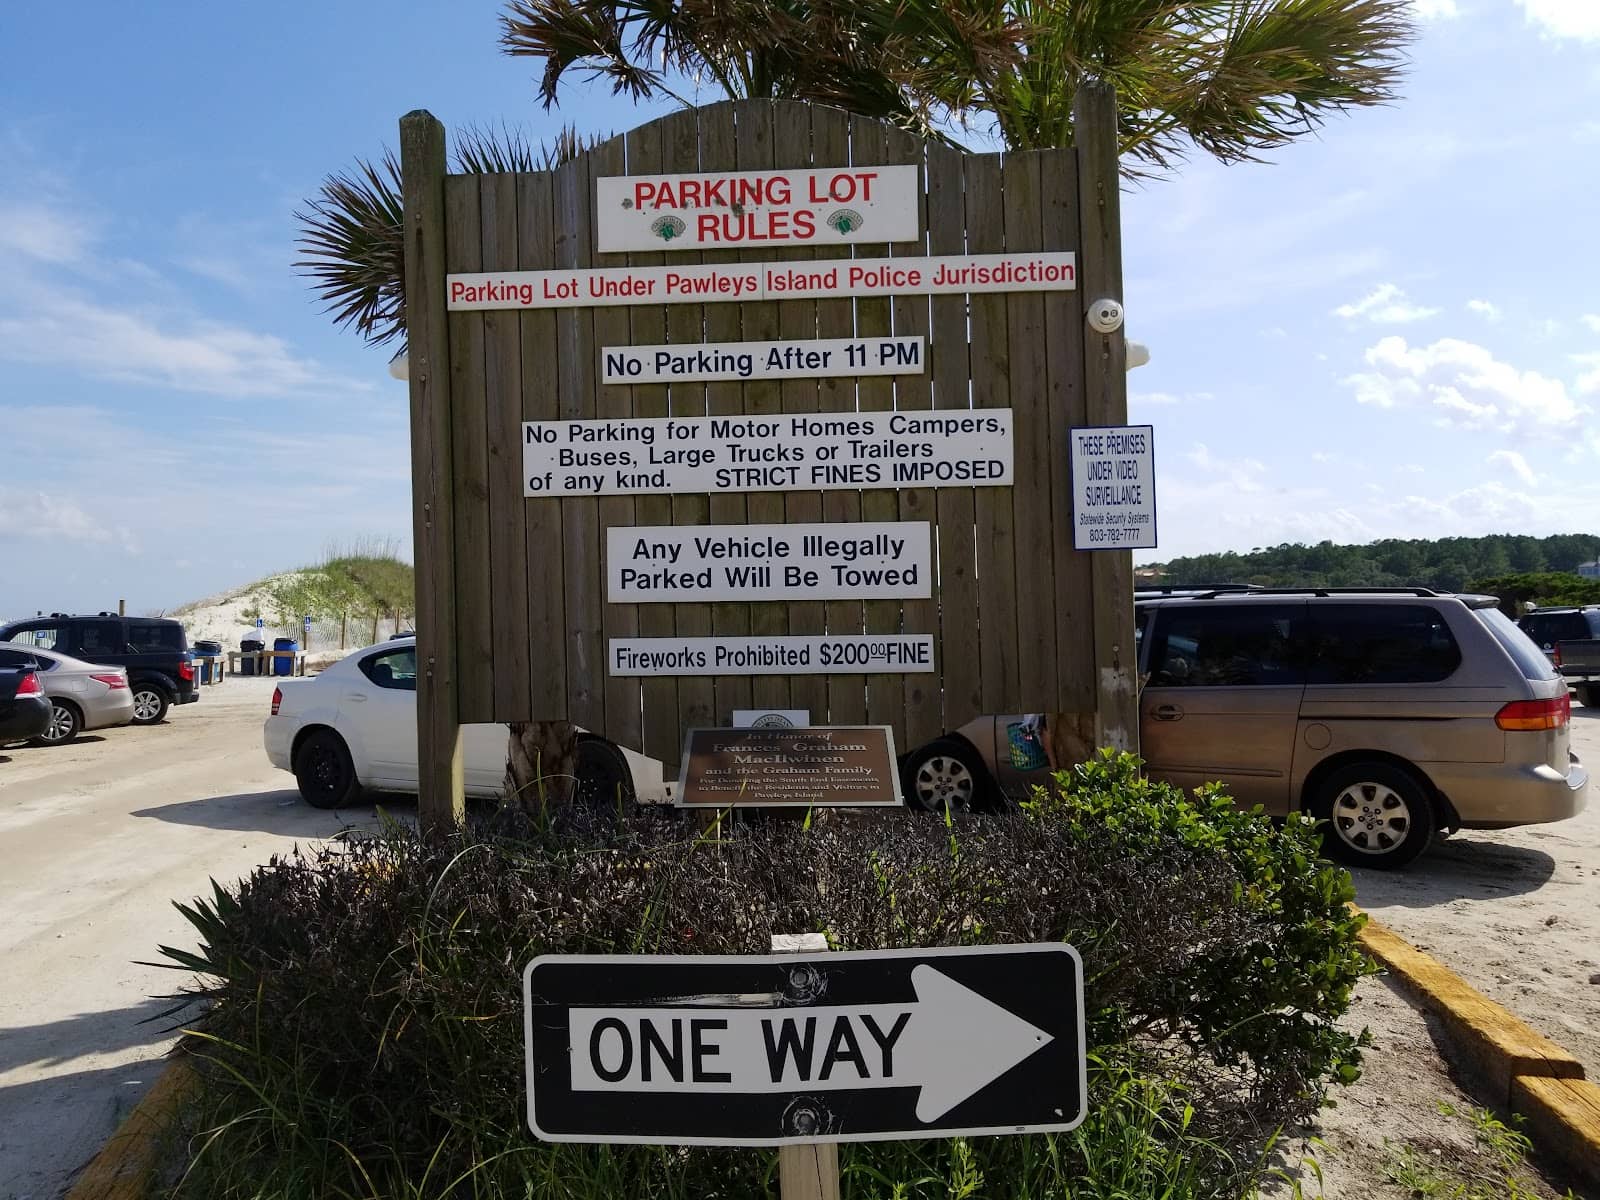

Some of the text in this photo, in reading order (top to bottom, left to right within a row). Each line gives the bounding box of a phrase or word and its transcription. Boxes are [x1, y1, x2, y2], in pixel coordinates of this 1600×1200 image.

[634, 173, 878, 210] PARKING LOT
[698, 210, 816, 242] RULES
[451, 260, 1075, 304] Parking Lot Under Pawleys Island Police Jurisdiction
[606, 342, 919, 376] No Parking After 11 PM
[526, 415, 1006, 444] No Parking for Motor Homes Campers,
[559, 439, 934, 468] Buses, Large Trucks or Trailers
[1078, 434, 1146, 456] THESE PREMISES
[529, 460, 1004, 493] of any kind. STRICT FINES IMPOSED
[1087, 460, 1138, 481] UNDER VIDEO
[1086, 485, 1142, 506] SURVEILLANCE
[1105, 512, 1127, 527] Security
[1128, 511, 1150, 527] Systems
[1089, 528, 1140, 542] 803-782-7777
[632, 535, 905, 563] Any Vehicle Illegally
[620, 564, 918, 589] Parked Will Be Towed
[616, 647, 706, 669] Fireworks
[715, 645, 810, 666] Prohibited
[792, 742, 867, 751] Graham
[817, 732, 833, 741] of
[763, 766, 820, 774] Graham
[825, 766, 872, 774] Family
[588, 1012, 912, 1084] ONE WAY
